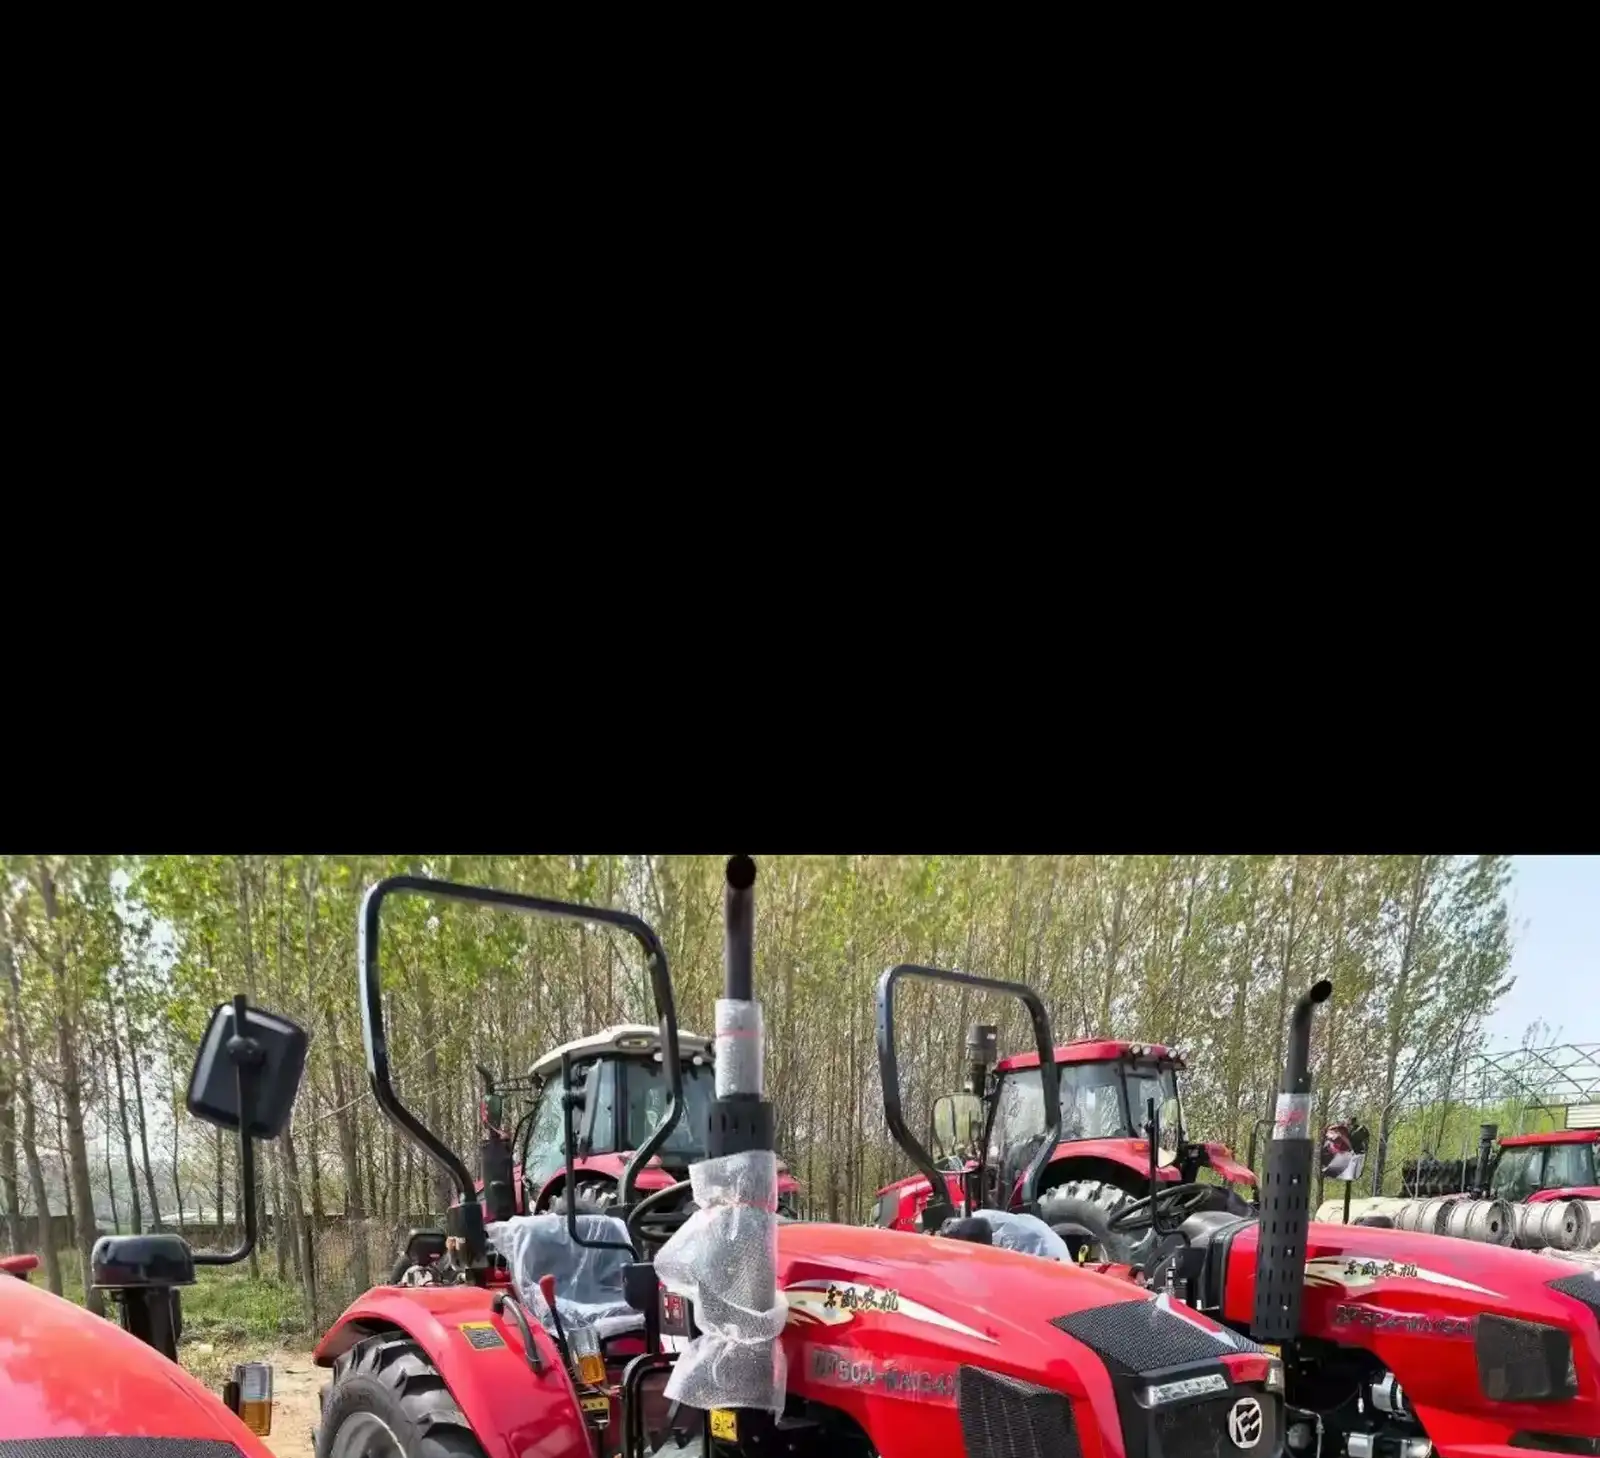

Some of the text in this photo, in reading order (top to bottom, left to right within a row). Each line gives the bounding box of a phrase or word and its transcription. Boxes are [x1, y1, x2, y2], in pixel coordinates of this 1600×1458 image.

[1344, 1259, 1418, 1278] 东风农机
[823, 1284, 899, 1312] 东风农机
